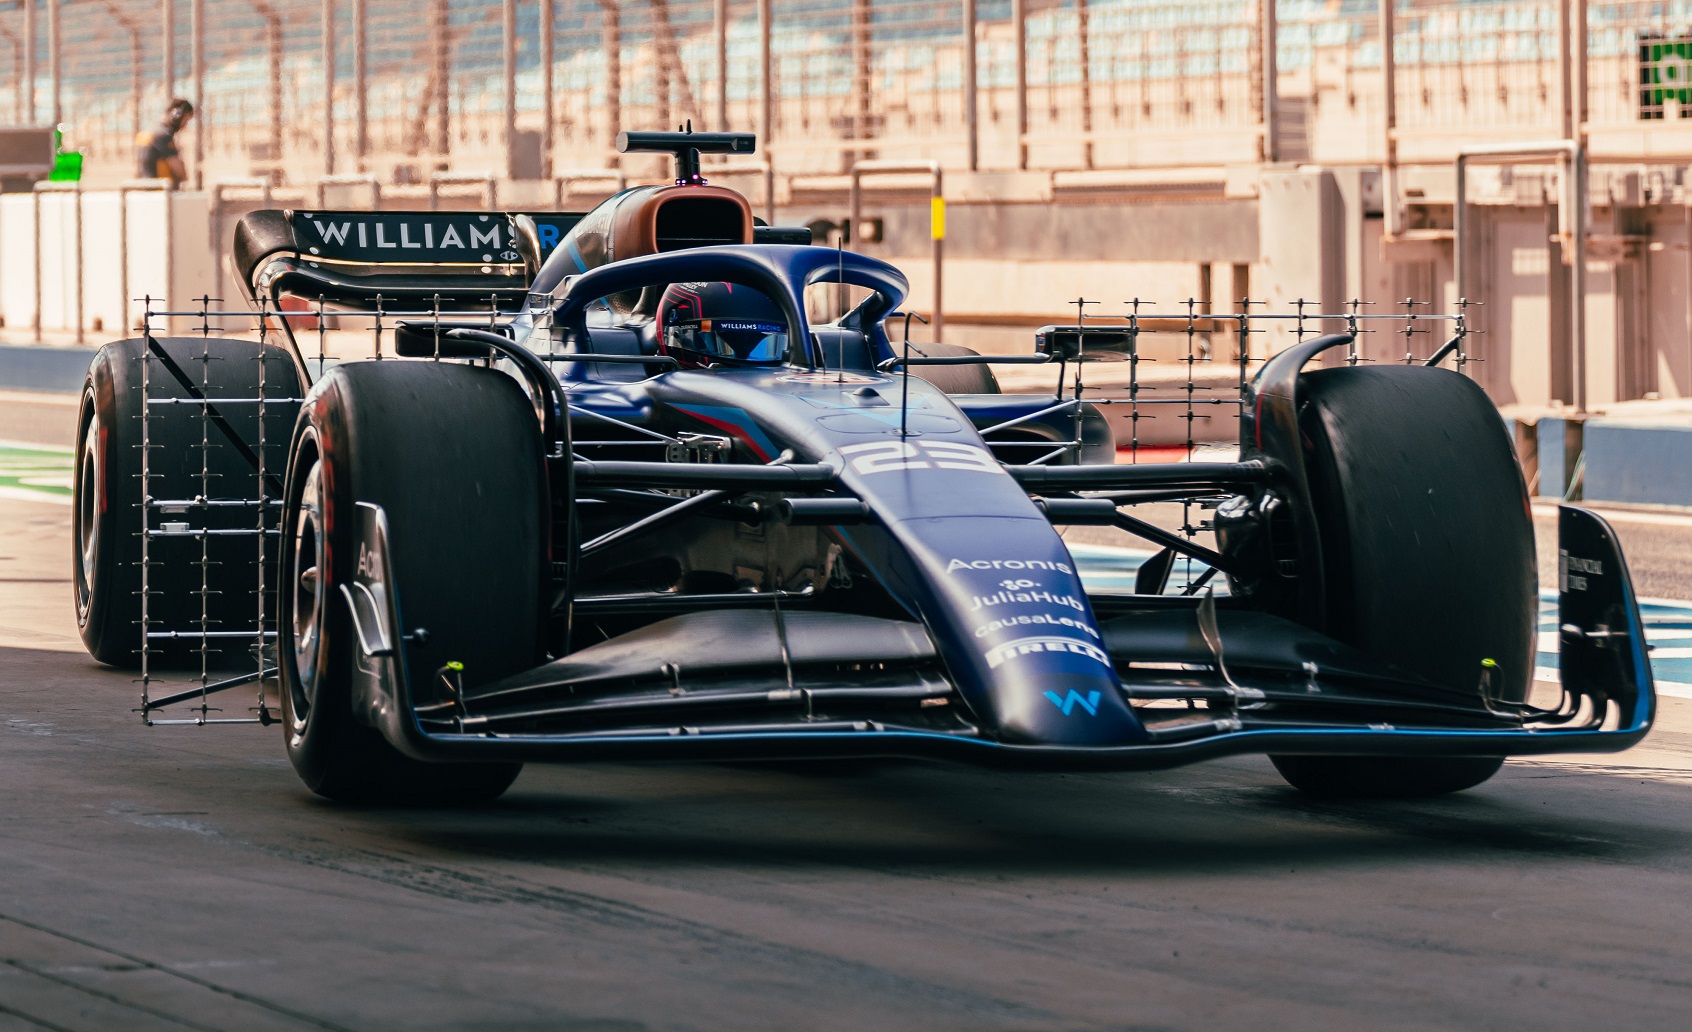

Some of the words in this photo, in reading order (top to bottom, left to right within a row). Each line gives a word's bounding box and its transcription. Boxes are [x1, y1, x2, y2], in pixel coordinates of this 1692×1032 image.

[836, 440, 1007, 476] 23
[946, 558, 1073, 575] Acronis
[970, 591, 1085, 612] JuliaHub
